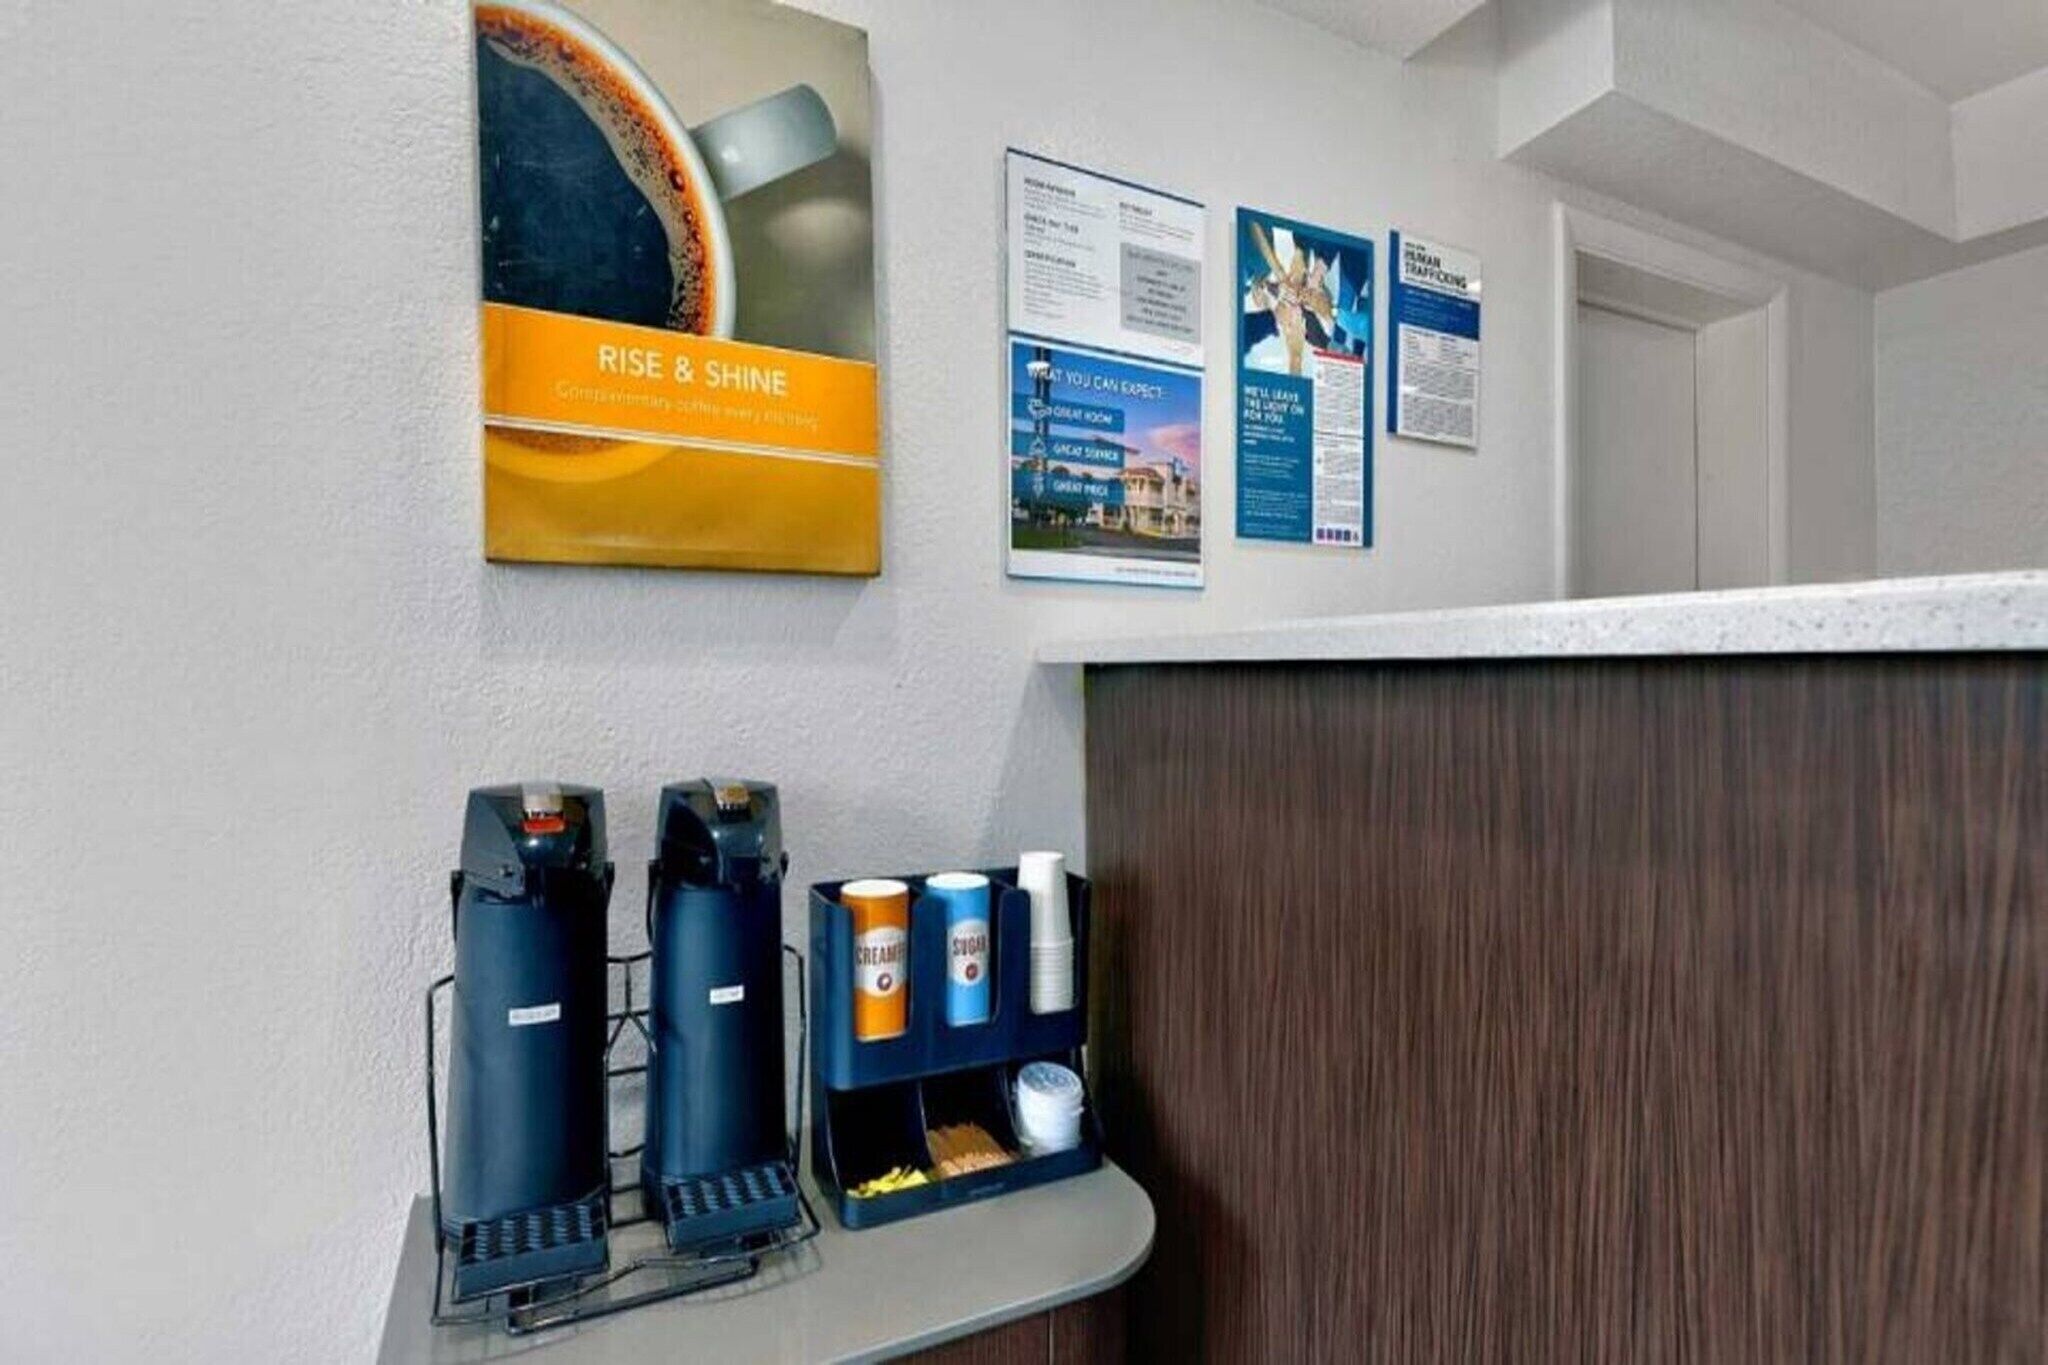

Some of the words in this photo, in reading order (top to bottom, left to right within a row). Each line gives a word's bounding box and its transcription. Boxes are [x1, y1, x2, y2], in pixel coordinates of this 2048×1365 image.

[1405, 251, 1441, 275] HUMAN
[1405, 262, 1467, 289] TRAFFICKING
[599, 344, 663, 379] RISE
[673, 354, 694, 384] &
[705, 360, 787, 396] SHINE
[1026, 363, 1062, 382] WHAT
[1066, 370, 1091, 388] YOU
[1094, 376, 1119, 393] CAN
[1053, 405, 1083, 419] GREAT
[1083, 410, 1113, 425] ROOM
[1053, 442, 1083, 456] GREAT
[1084, 446, 1119, 462] SERVICE
[1053, 480, 1083, 494] GREAT
[1084, 483, 1109, 497] PRICE
